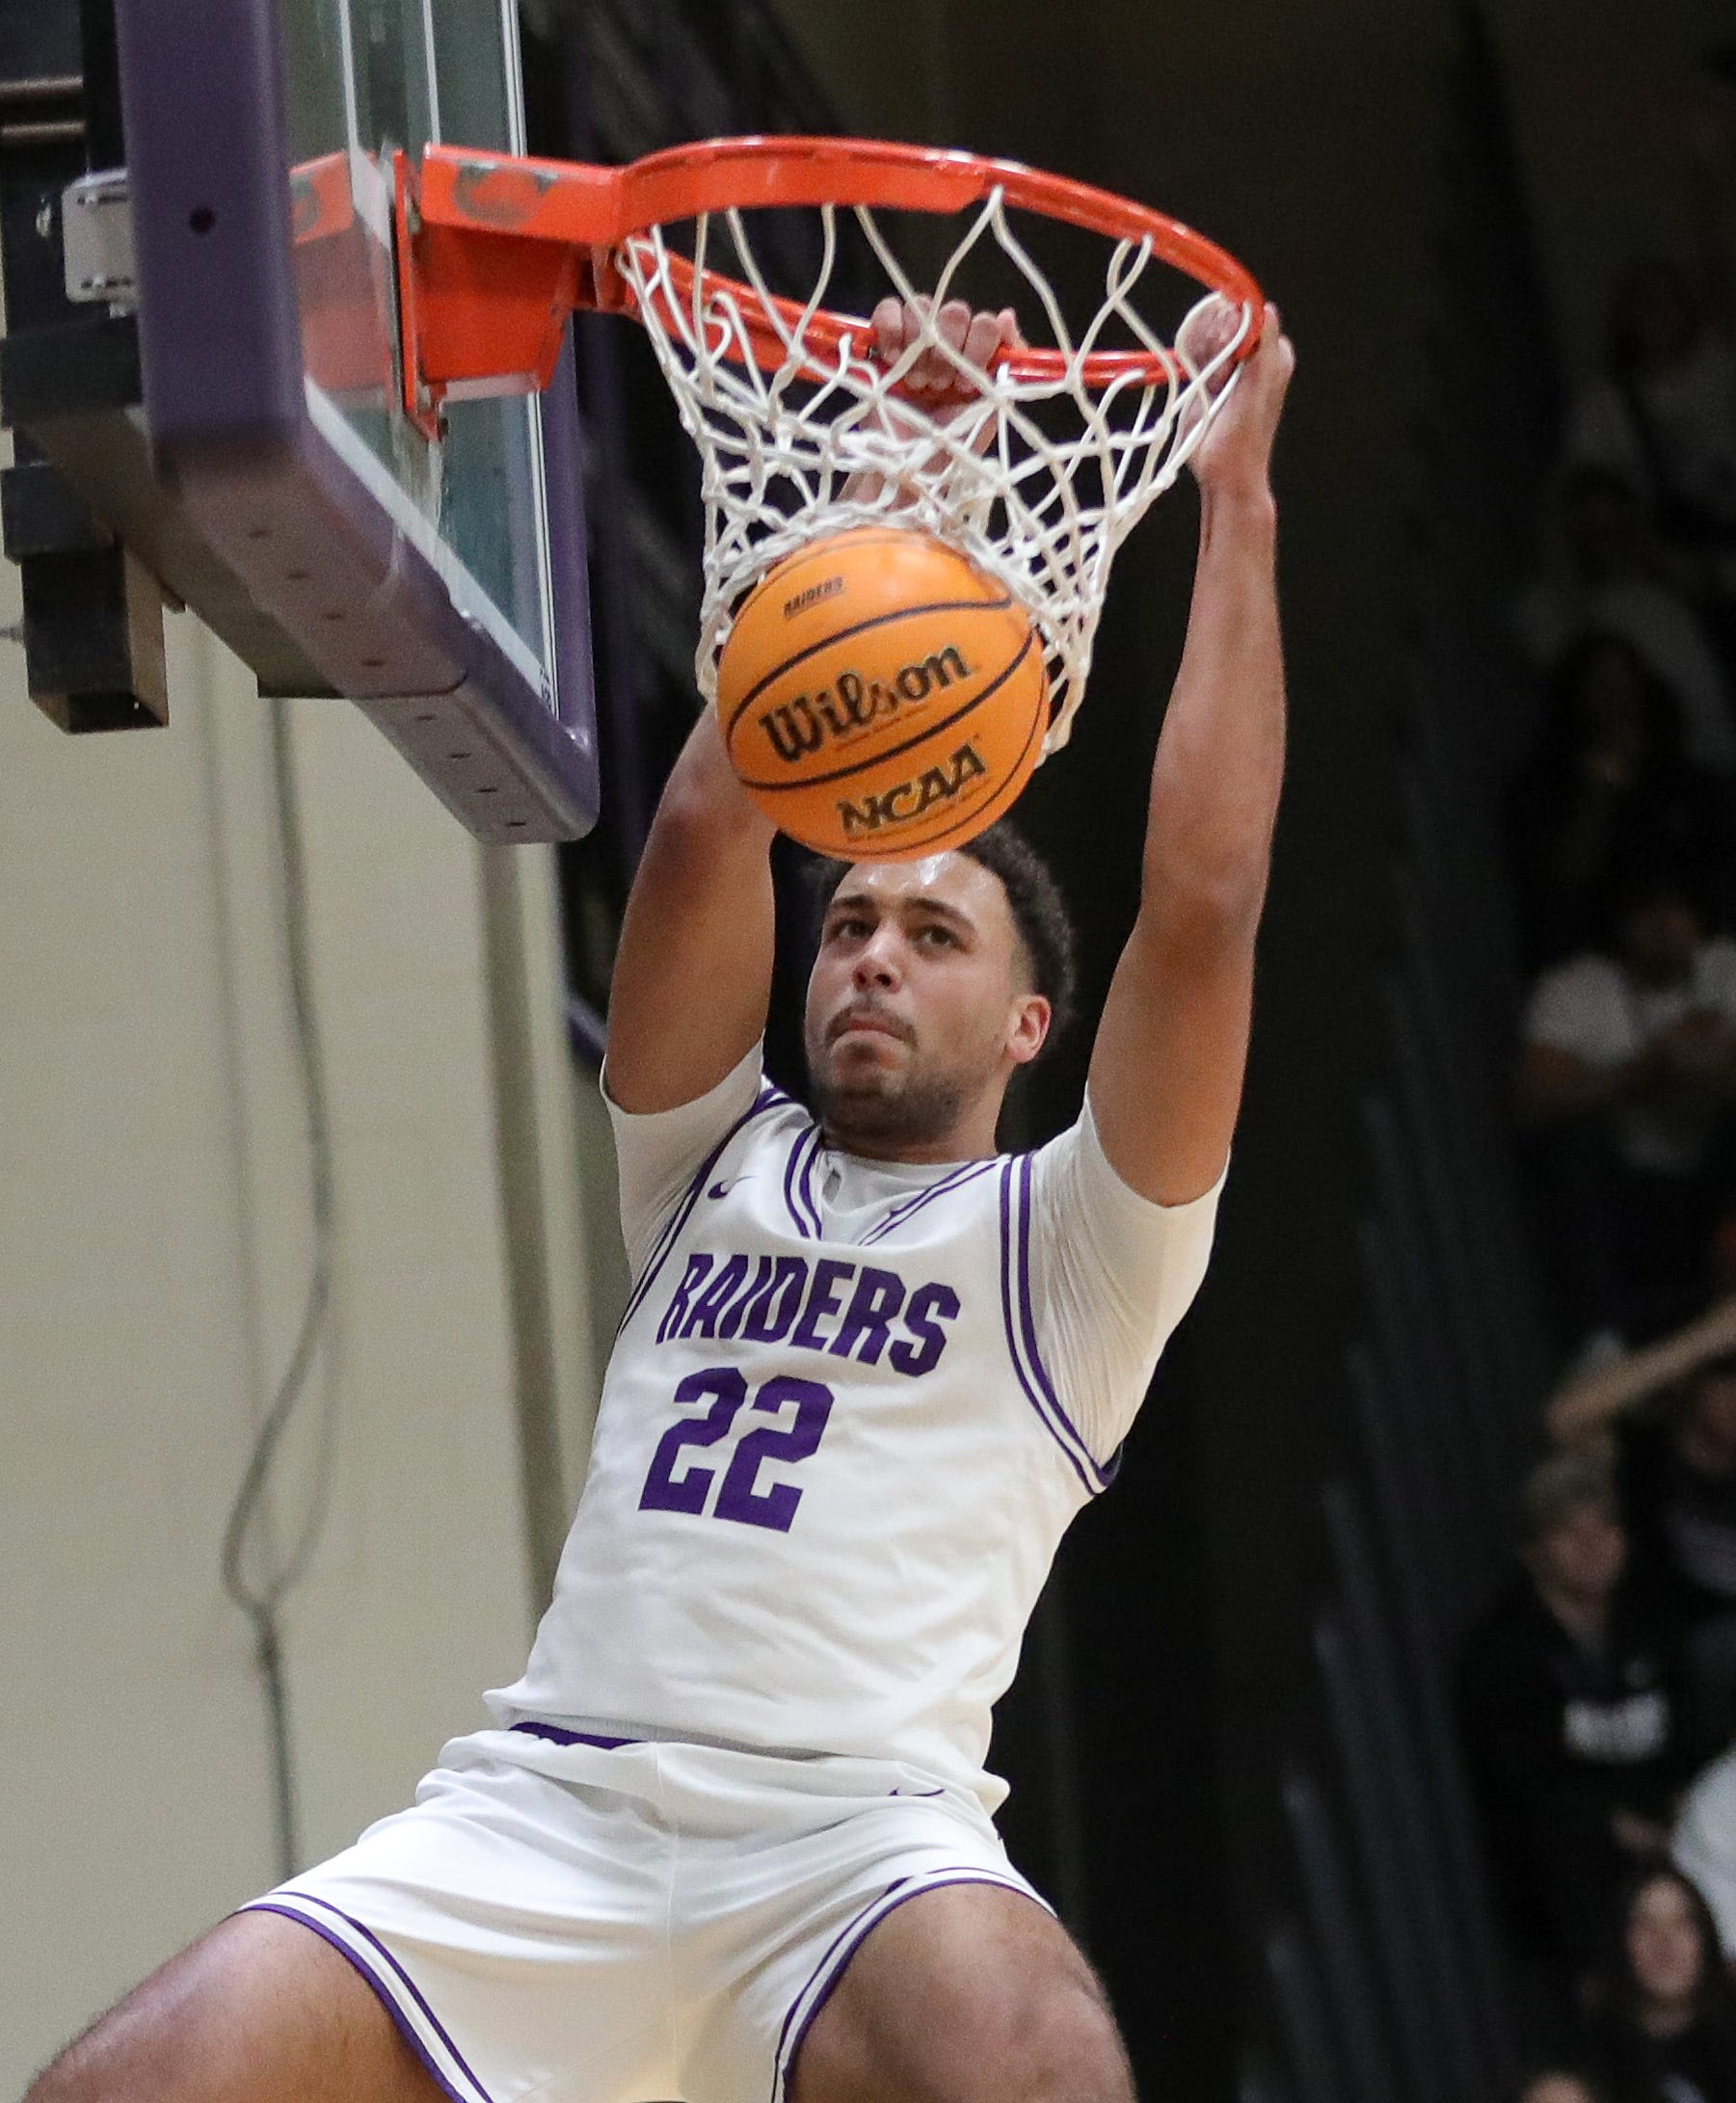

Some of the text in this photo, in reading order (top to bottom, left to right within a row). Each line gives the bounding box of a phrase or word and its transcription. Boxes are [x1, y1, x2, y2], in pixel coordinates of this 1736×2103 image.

[758, 645, 971, 762] Wilson
[836, 742, 987, 832] NCAA
[655, 1254, 961, 1377] RAIDERS
[638, 1368, 835, 1532] 22
